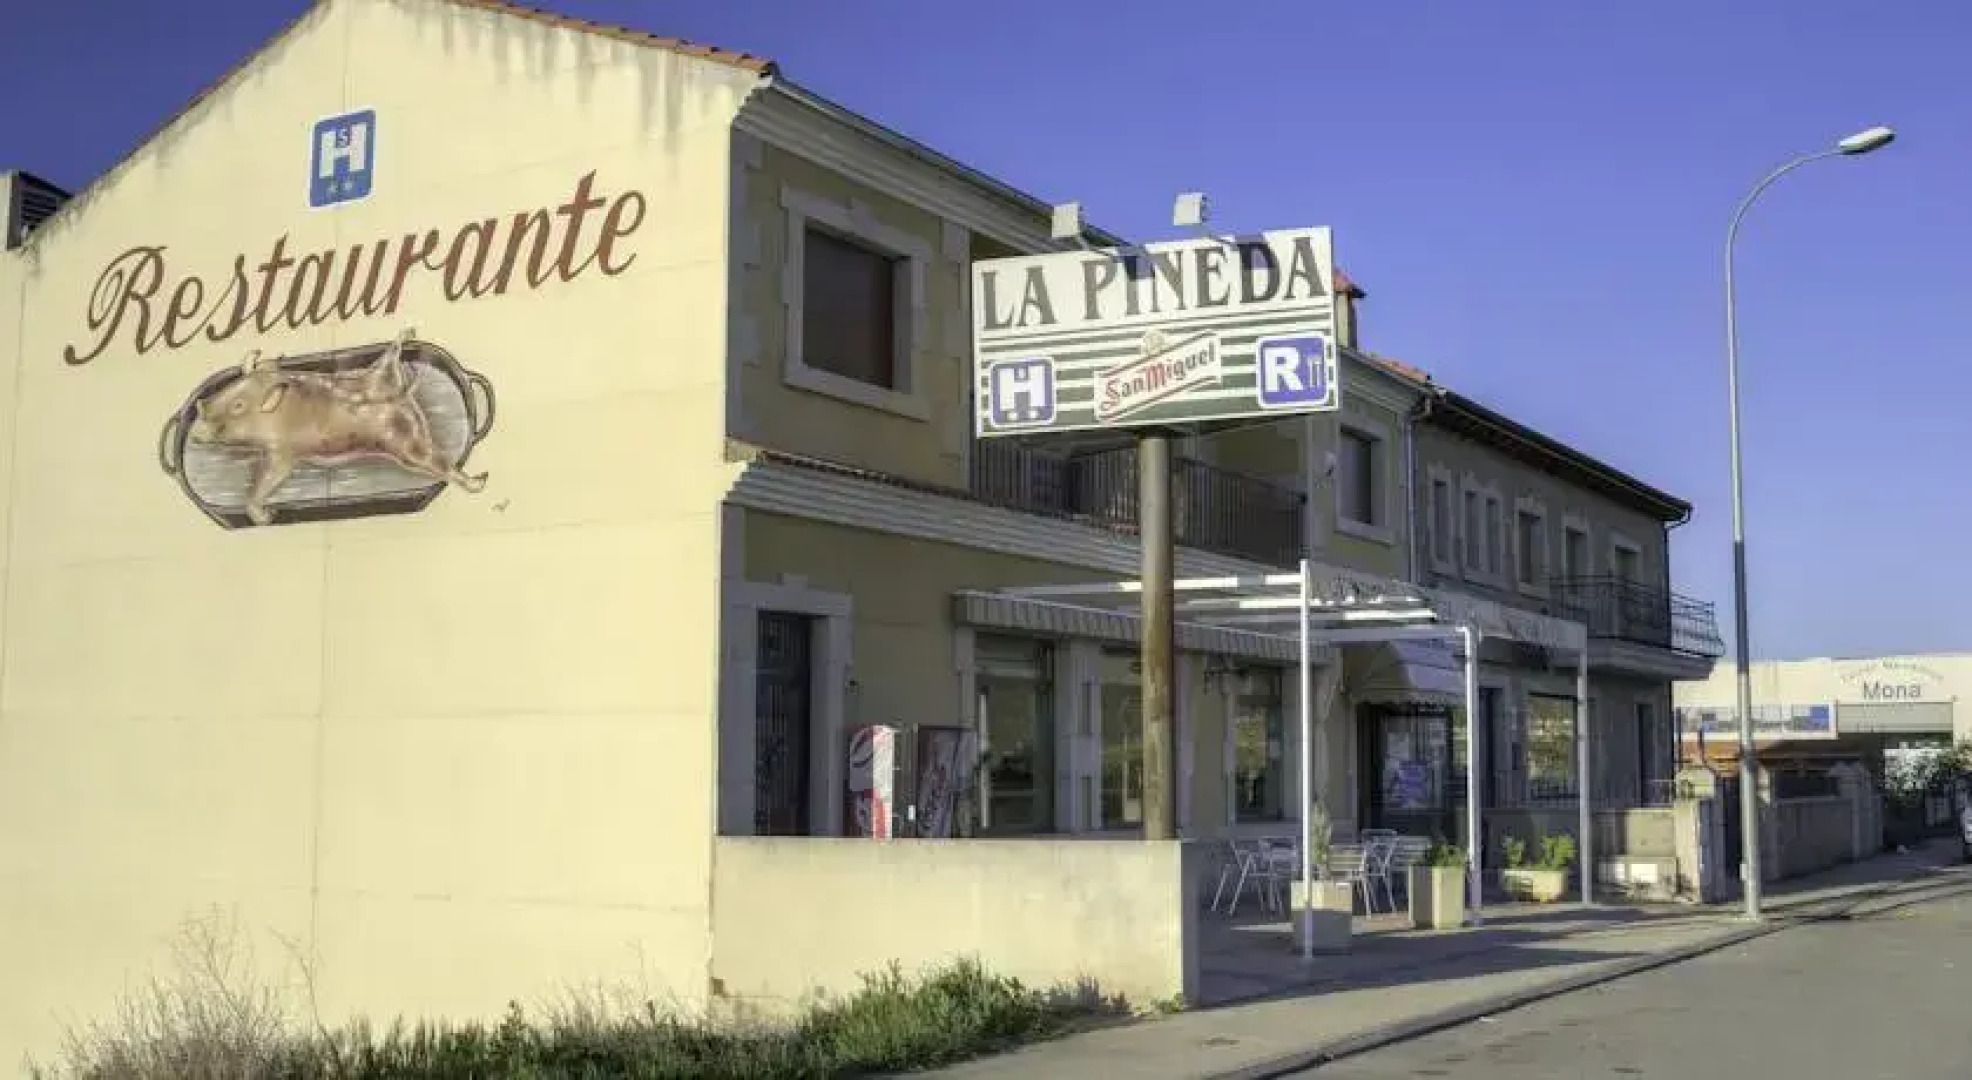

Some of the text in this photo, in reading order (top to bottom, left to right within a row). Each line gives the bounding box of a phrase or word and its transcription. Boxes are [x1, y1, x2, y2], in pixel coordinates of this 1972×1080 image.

[319, 122, 367, 178] H
[63, 169, 647, 367] Restaurante
[980, 236, 1328, 330] LA PINEDA
[999, 365, 1046, 410] H
[1264, 347, 1304, 393] R
[1863, 680, 1921, 699] Mona
